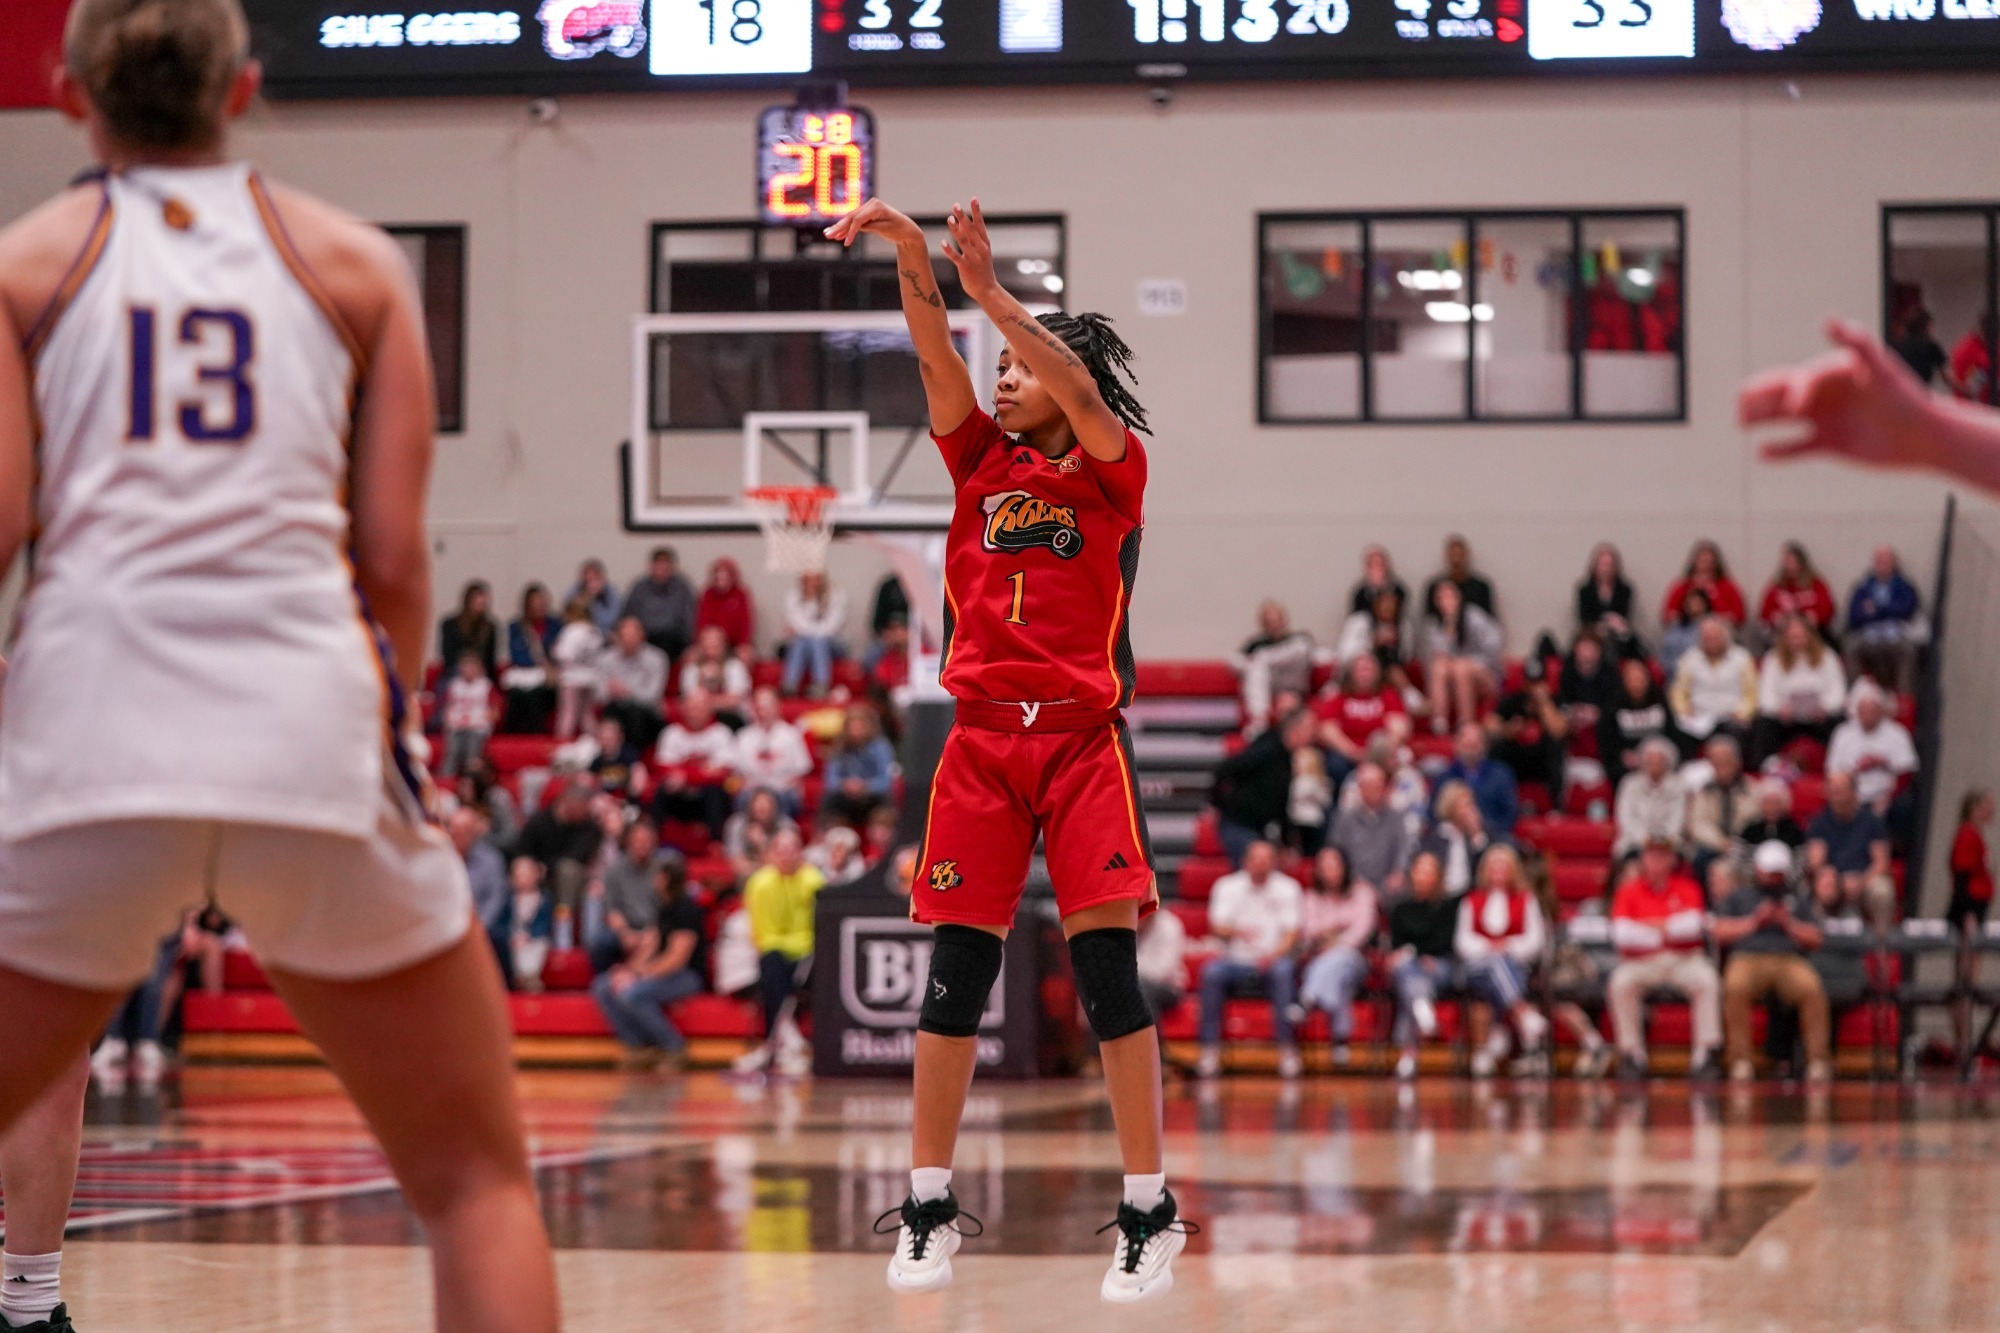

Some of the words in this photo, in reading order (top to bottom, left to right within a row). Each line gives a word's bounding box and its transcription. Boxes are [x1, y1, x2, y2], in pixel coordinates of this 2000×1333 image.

[699, 0, 763, 45] 18
[1127, 0, 1279, 42] 1:13
[768, 142, 862, 216] 20
[126, 303, 256, 446] 13
[1003, 570, 1028, 626] 1
